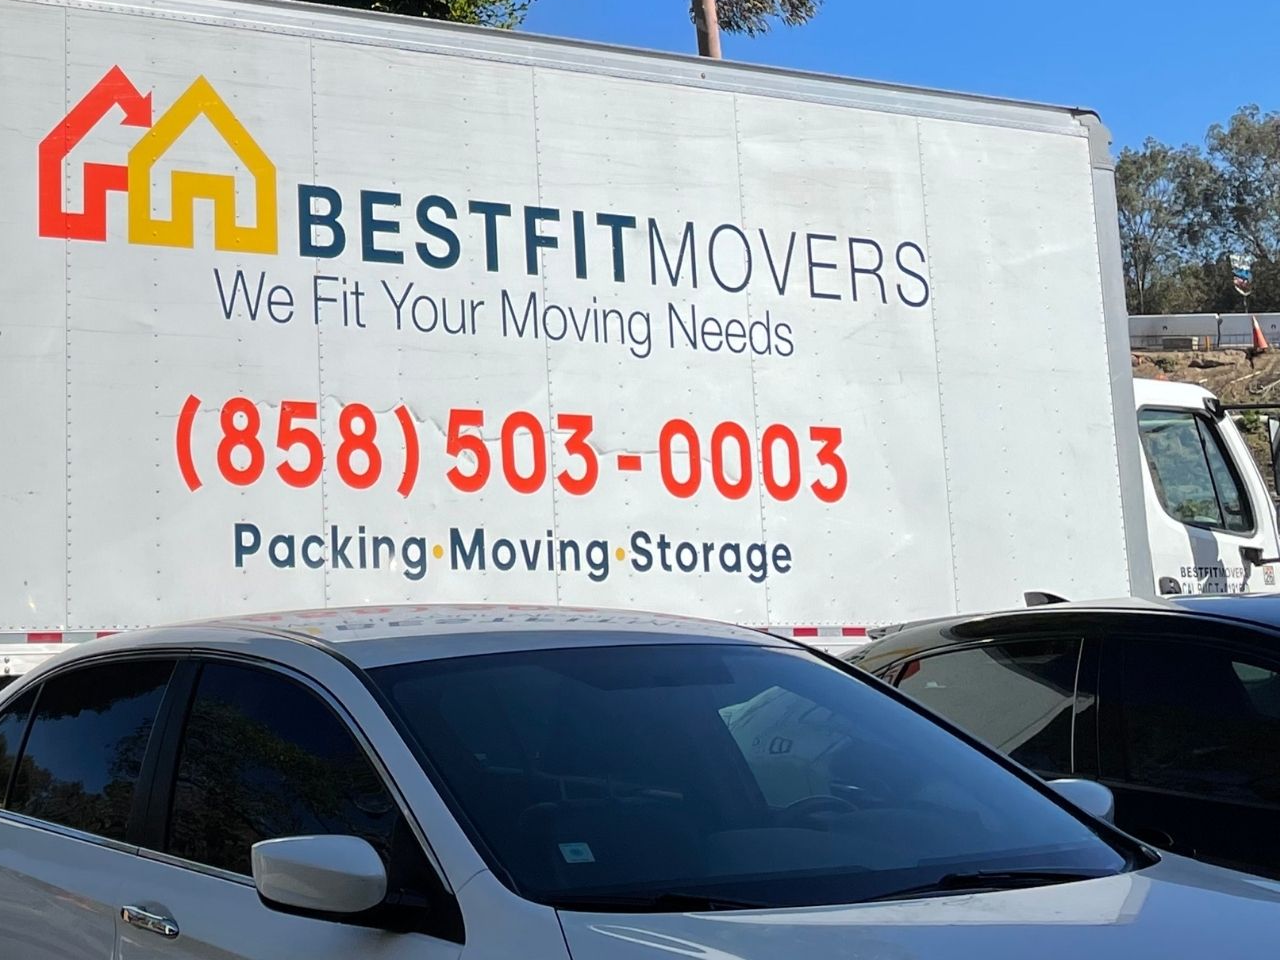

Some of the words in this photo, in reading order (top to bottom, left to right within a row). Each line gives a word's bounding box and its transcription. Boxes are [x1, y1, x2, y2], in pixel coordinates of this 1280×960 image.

[213, 267, 295, 324] We
[312, 274, 366, 329] Fit
[380, 279, 485, 335] Your
[500, 288, 652, 359] Moving
[667, 301, 795, 357] Needs
[176, 393, 420, 498] (858)
[445, 407, 849, 504] 503-0003
